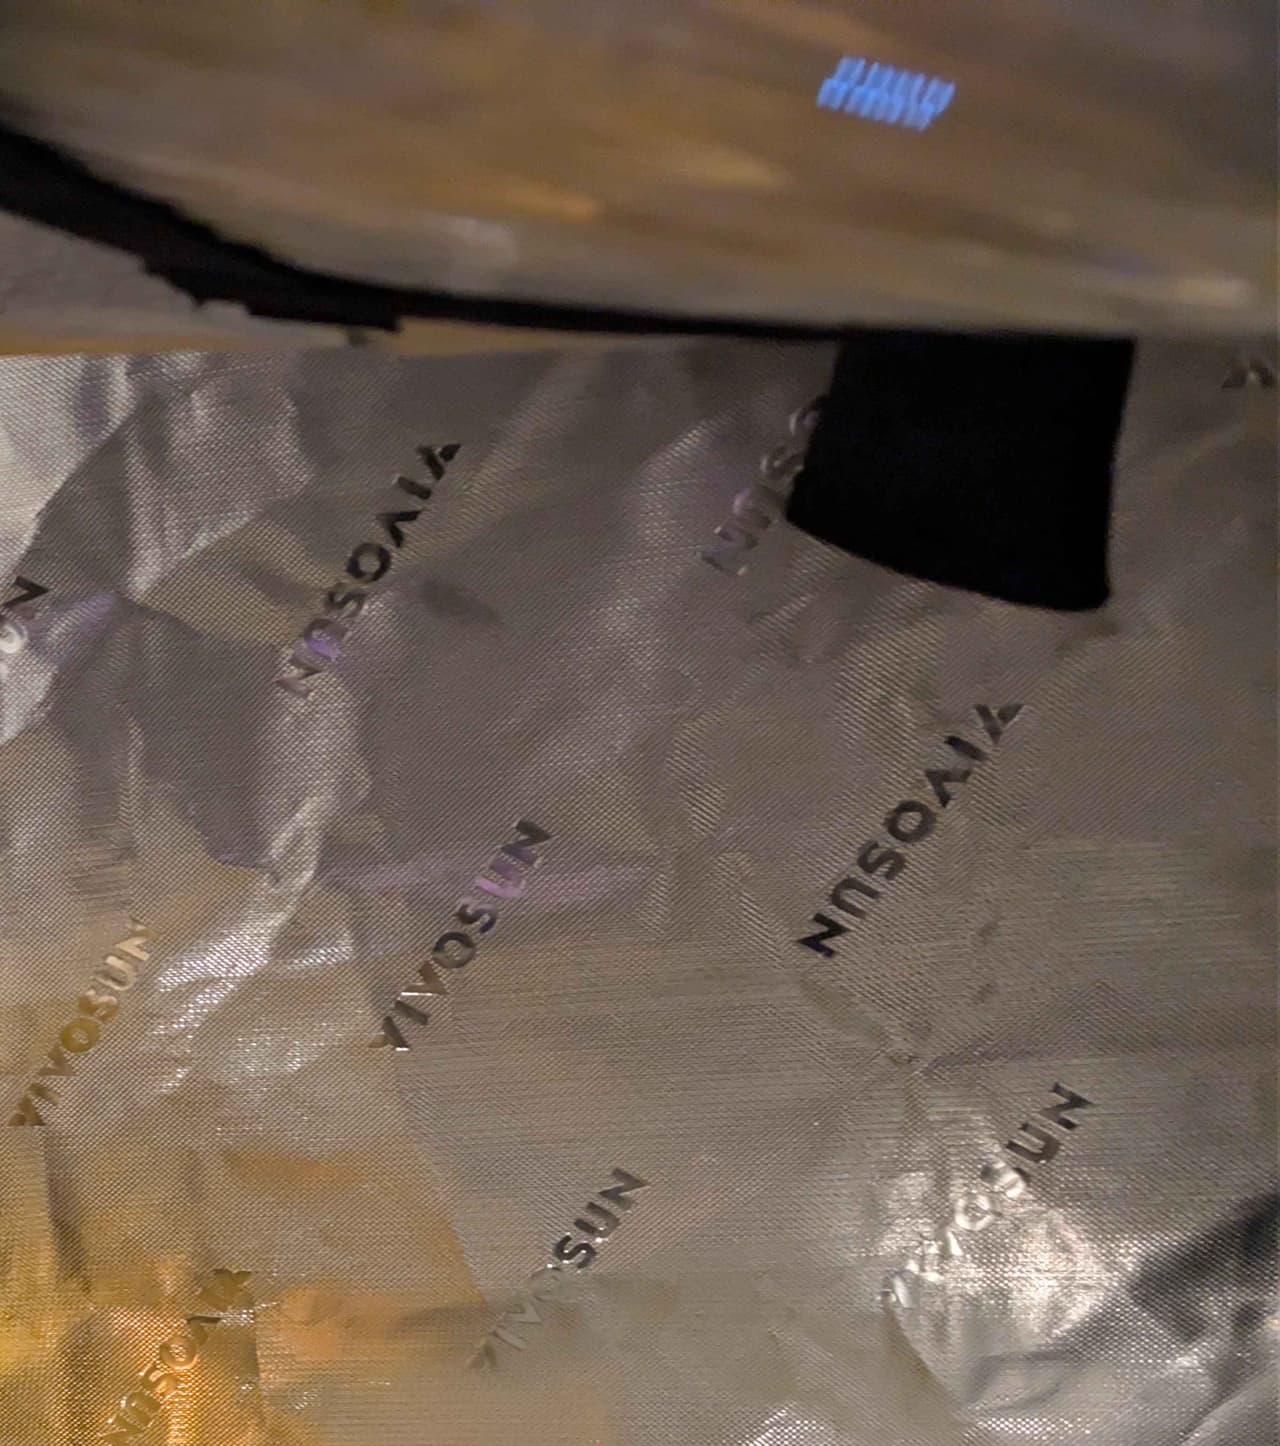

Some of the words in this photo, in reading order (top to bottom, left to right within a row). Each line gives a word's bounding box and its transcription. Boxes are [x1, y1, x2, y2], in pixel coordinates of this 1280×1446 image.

[276, 443, 461, 697] VIVOSUN
[369, 819, 552, 1052] VIVOSUN
[795, 702, 1026, 958] VIVOSUN
[8, 912, 160, 1128] VIVOSUN
[468, 1166, 650, 1370] VIVOSUN
